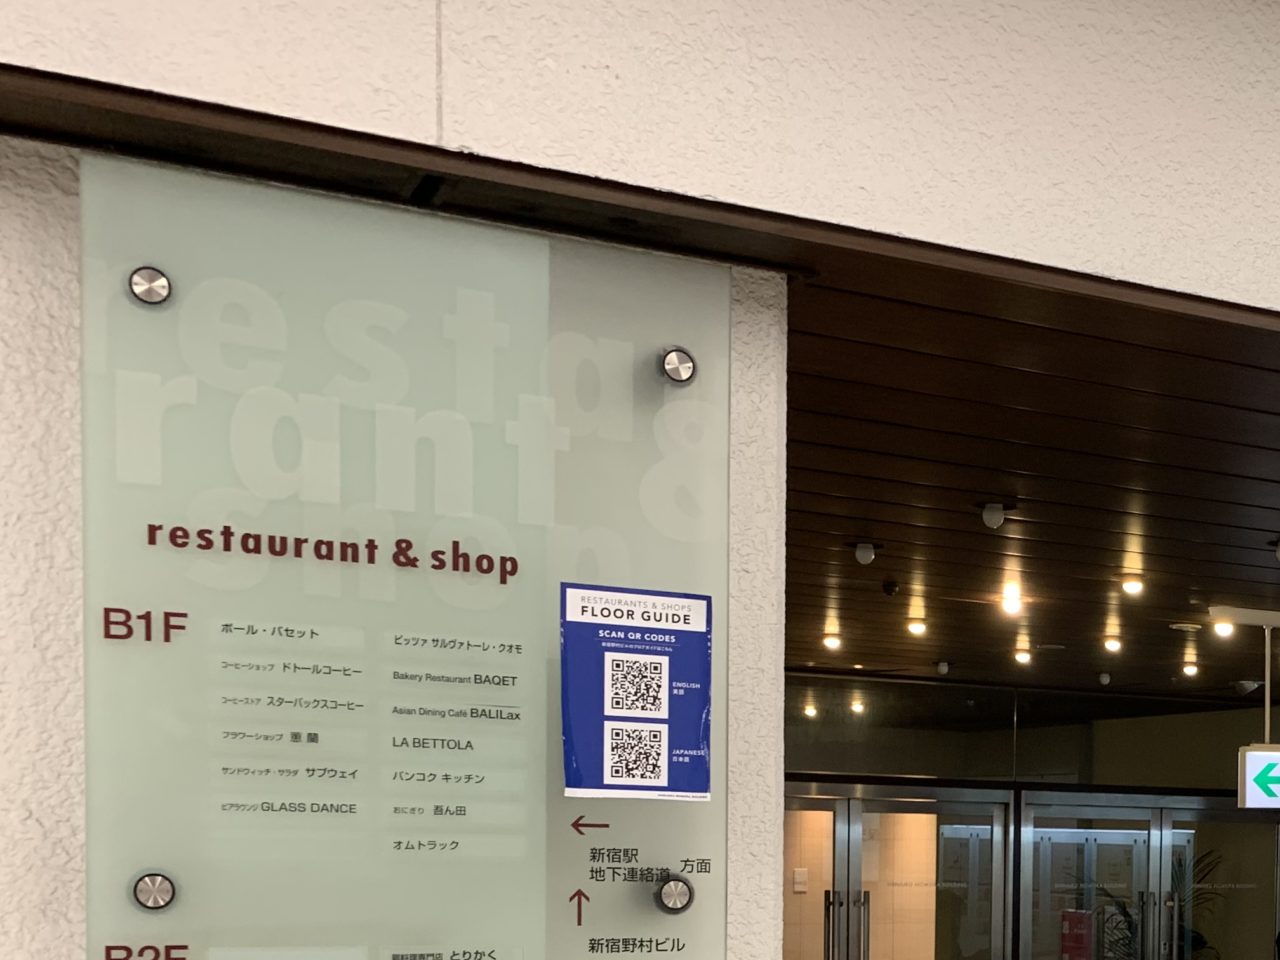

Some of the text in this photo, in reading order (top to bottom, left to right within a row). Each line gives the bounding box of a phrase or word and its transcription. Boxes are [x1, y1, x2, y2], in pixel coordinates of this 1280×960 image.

[147, 523, 519, 585] restaurant & shop
[581, 596, 648, 609] RESTAURANTS
[661, 603, 692, 613] SHOPS
[581, 606, 691, 625] FLOOR GUIDE
[103, 607, 188, 642] B1F
[598, 630, 676, 643] SCAN QR CODES
[431, 638, 523, 654] サルヴァトーレ・クオモ
[281, 662, 363, 676] ドトールコーヒー
[393, 671, 517, 686] Bakery Restaurant BAQET
[266, 696, 364, 711] スターバックスコーヒー
[392, 706, 521, 721] Asian Dining Café BALILax
[222, 731, 283, 742] フラワーショップ
[392, 737, 474, 750] LA BETTOLA
[672, 748, 706, 756] JAPANESE
[305, 767, 358, 779] サブウェイ
[392, 771, 485, 784] バンコク キッチン
[260, 801, 306, 813] GLASS
[311, 802, 357, 814] DANCE
[393, 806, 424, 815] おにぎり
[393, 840, 459, 851] オムトラック
[589, 848, 638, 863] 新宿駅
[680, 858, 711, 874] 方面
[589, 867, 670, 883] 地下連絡道
[588, 938, 685, 953] 新宿野村ビル
[450, 949, 497, 960] とりかく
